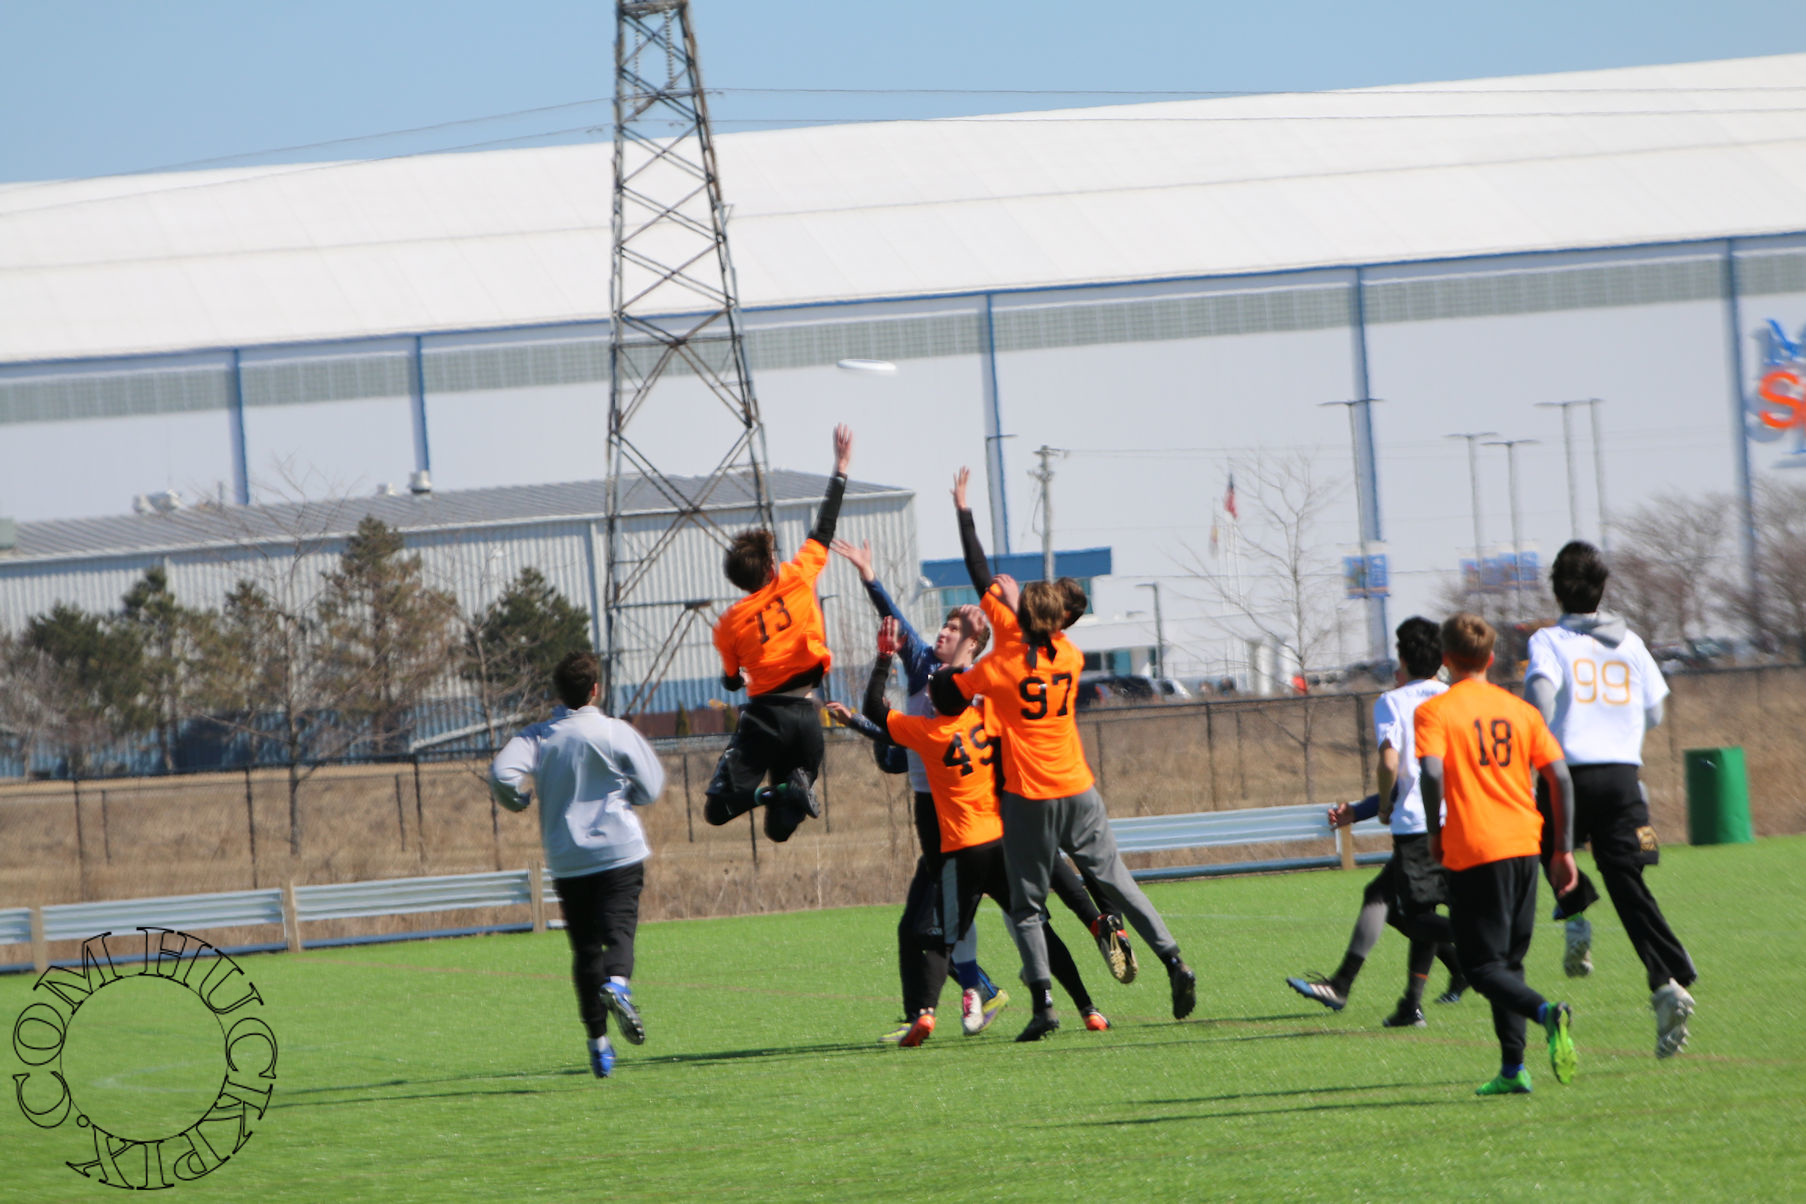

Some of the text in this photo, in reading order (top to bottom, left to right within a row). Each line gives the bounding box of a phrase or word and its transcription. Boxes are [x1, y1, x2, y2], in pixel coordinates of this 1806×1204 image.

[1019, 673, 1072, 720] 97
[1573, 658, 1630, 705] 99
[1474, 718, 1512, 767] 18
